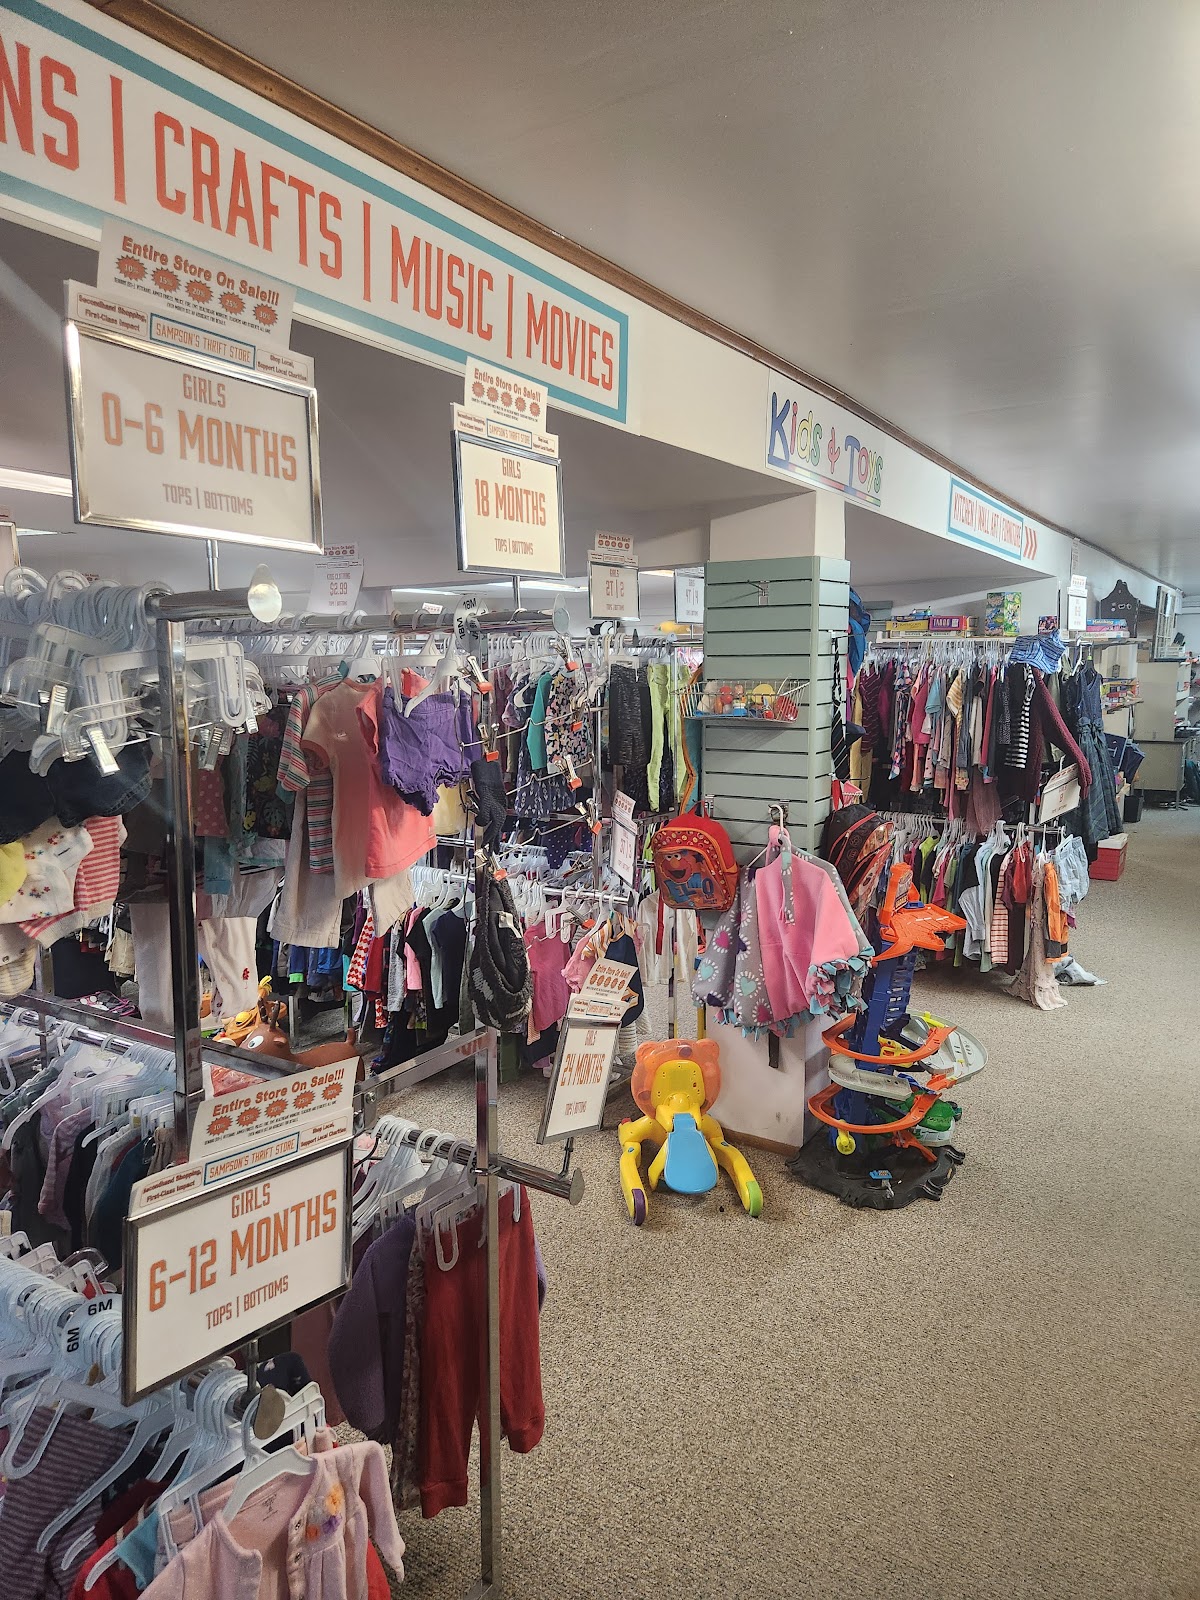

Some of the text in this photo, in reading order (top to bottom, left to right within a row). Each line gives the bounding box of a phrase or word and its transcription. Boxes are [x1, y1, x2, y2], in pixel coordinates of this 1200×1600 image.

[0, 34, 79, 171] NS
[155, 111, 343, 280] CRAFTS
[391, 225, 493, 341] MUSIC
[526, 292, 613, 391] MOVIES
[122, 236, 168, 265] Entire
[173, 255, 212, 281] Store
[217, 271, 235, 290] On
[239, 279, 280, 306] Sale!!!
[156, 323, 251, 363] SAMPSON'S THRIFT STORE
[182, 373, 226, 409] GIRLS
[474, 367, 494, 385] Entire
[495, 376, 512, 392] Store
[513, 383, 521, 396] On
[102, 391, 297, 482] 0-6 MONTHS
[768, 391, 823, 467] Kids
[501, 457, 521, 479] GIRLS
[162, 483, 193, 506] TOPS
[203, 491, 253, 516] BOTTOMS
[475, 478, 547, 527] 18 MONTHS
[494, 538, 508, 553] TOPS
[511, 540, 534, 555] BOTTOMS
[330, 582, 348, 596] $2.99
[560, 1053, 606, 1087] 24 MONTHS
[212, 1068, 345, 1117] Entire Store On Sale!!!
[209, 1138, 295, 1178] SAMPSON'S THRIFT STORE
[176, 1180, 195, 1192] Impact
[231, 1182, 271, 1219] GIRLS
[149, 1189, 337, 1312] 6-12 MONTHS
[88, 1299, 113, 1316] 6M
[206, 1302, 232, 1330] TOPS
[243, 1274, 289, 1313] BOTTOMS
[66, 1327, 80, 1353] 6M
